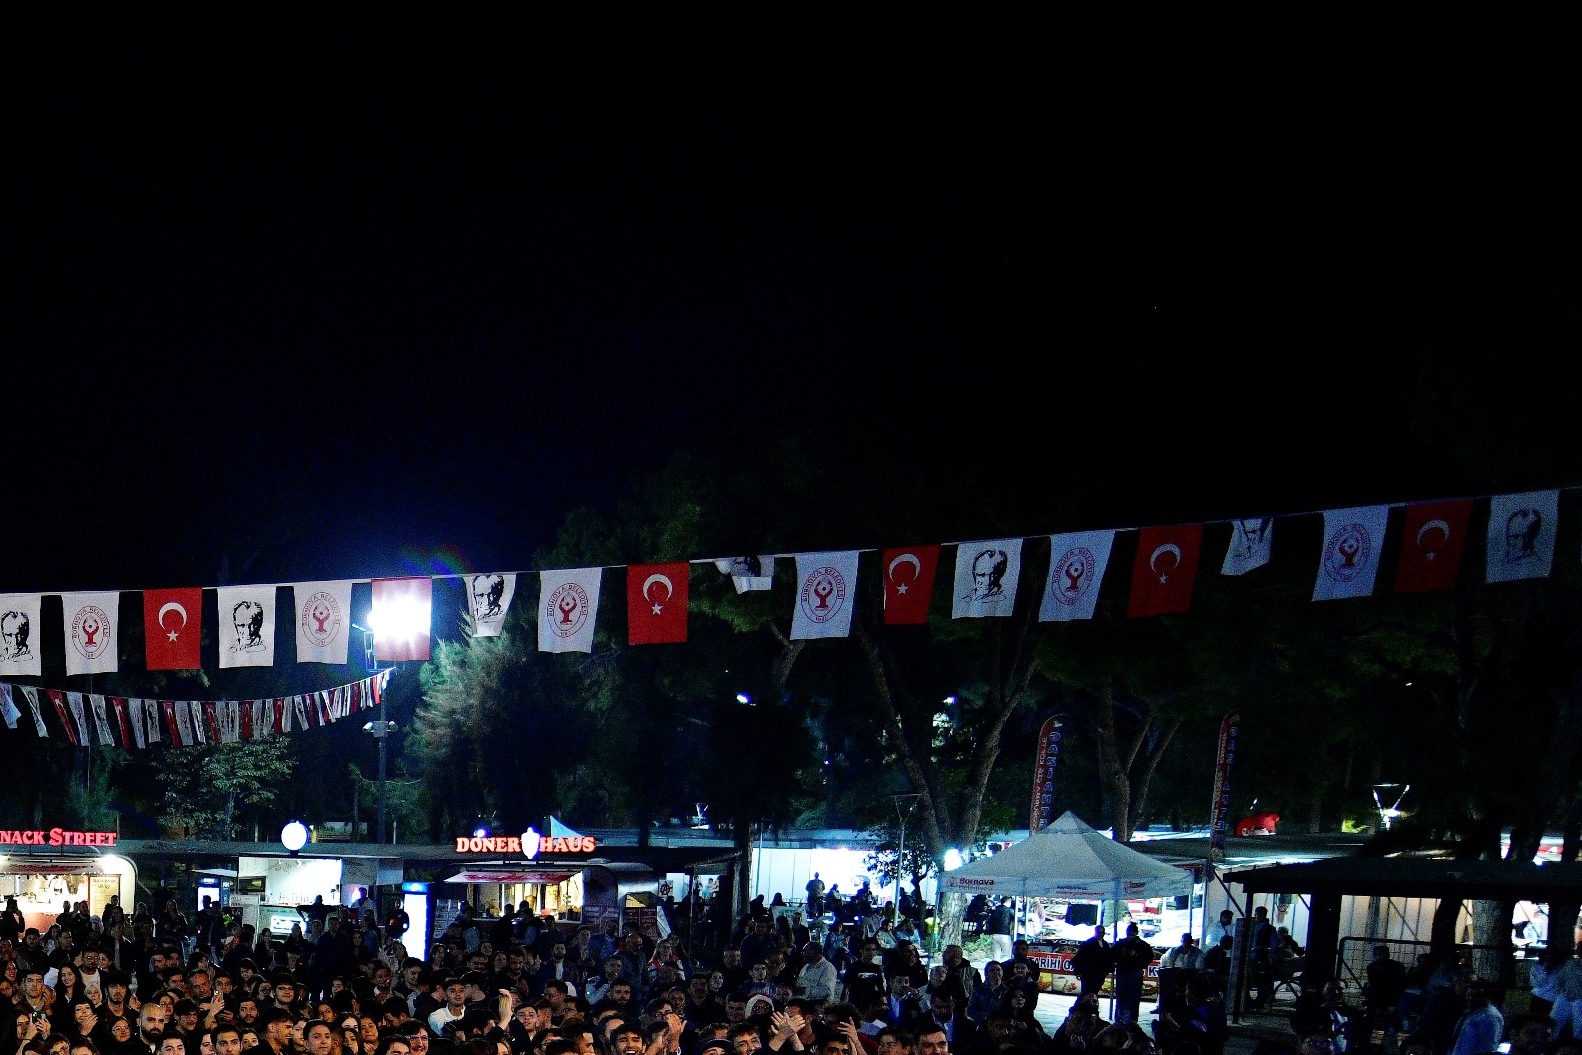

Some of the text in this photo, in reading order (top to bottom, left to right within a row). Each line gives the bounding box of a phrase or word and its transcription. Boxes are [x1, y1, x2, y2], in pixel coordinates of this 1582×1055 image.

[48, 827, 117, 847] STREET
[539, 836, 596, 852] HAUS
[959, 877, 995, 887] Bornova
